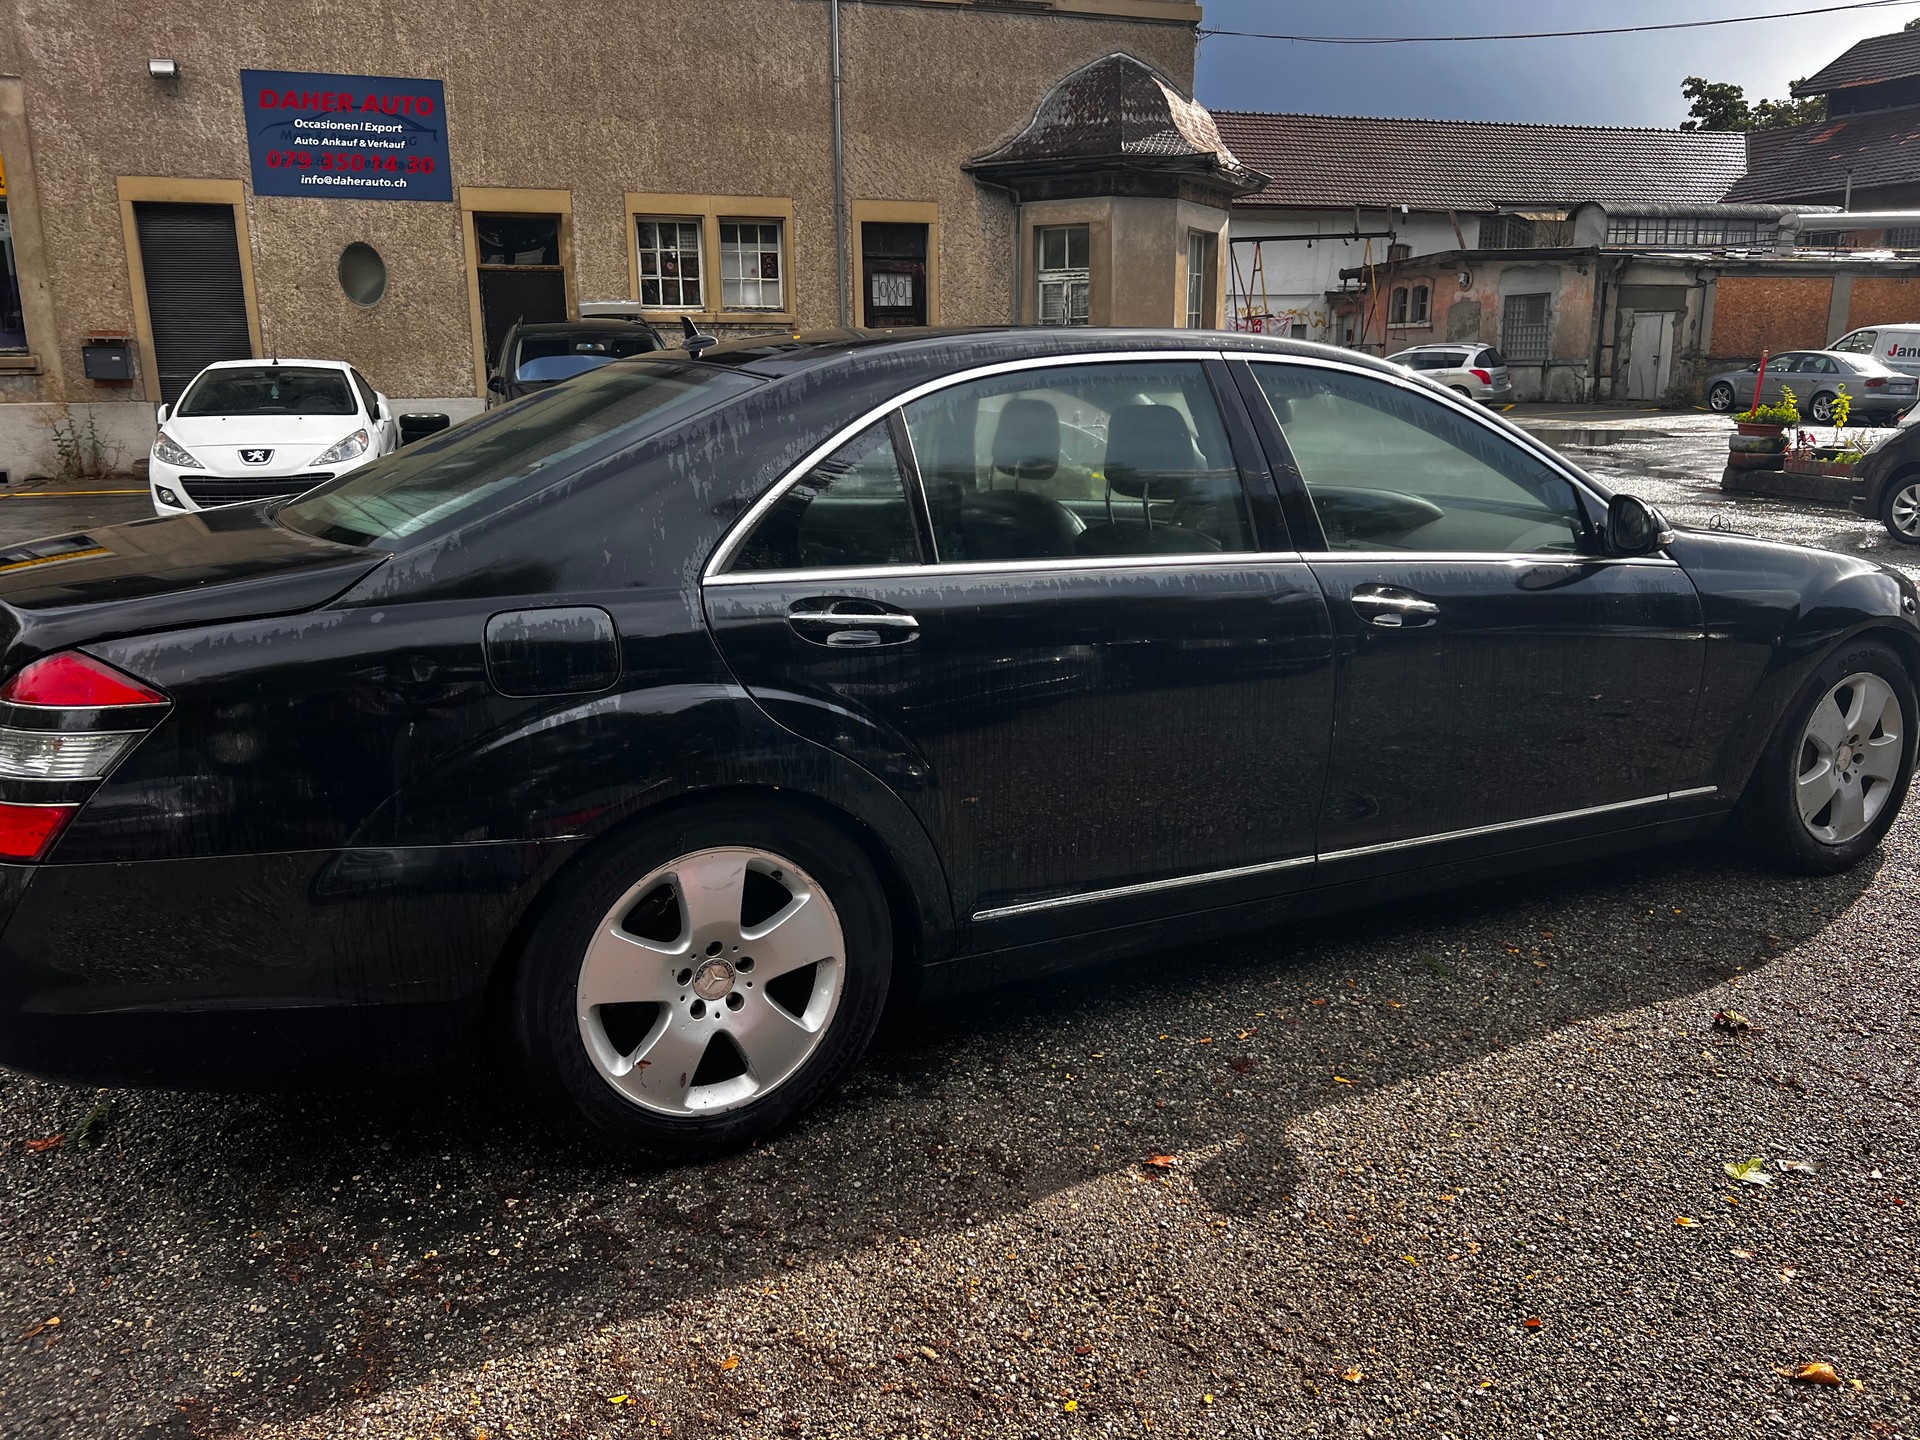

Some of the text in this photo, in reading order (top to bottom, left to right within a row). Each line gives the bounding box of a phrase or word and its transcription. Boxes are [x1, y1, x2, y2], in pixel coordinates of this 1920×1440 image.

[259, 89, 435, 116] DAHER AUTO
[294, 118, 359, 131] Occasionen
[364, 122, 403, 134] Export
[294, 136, 319, 145] Auto
[321, 137, 358, 147] Ankauf
[367, 139, 406, 149] Verkauf
[266, 149, 313, 170] 079
[320, 152, 365, 172] 350
[371, 154, 398, 173] 14
[406, 155, 435, 175] 30
[300, 174, 407, 188] info@daherauto.ch
